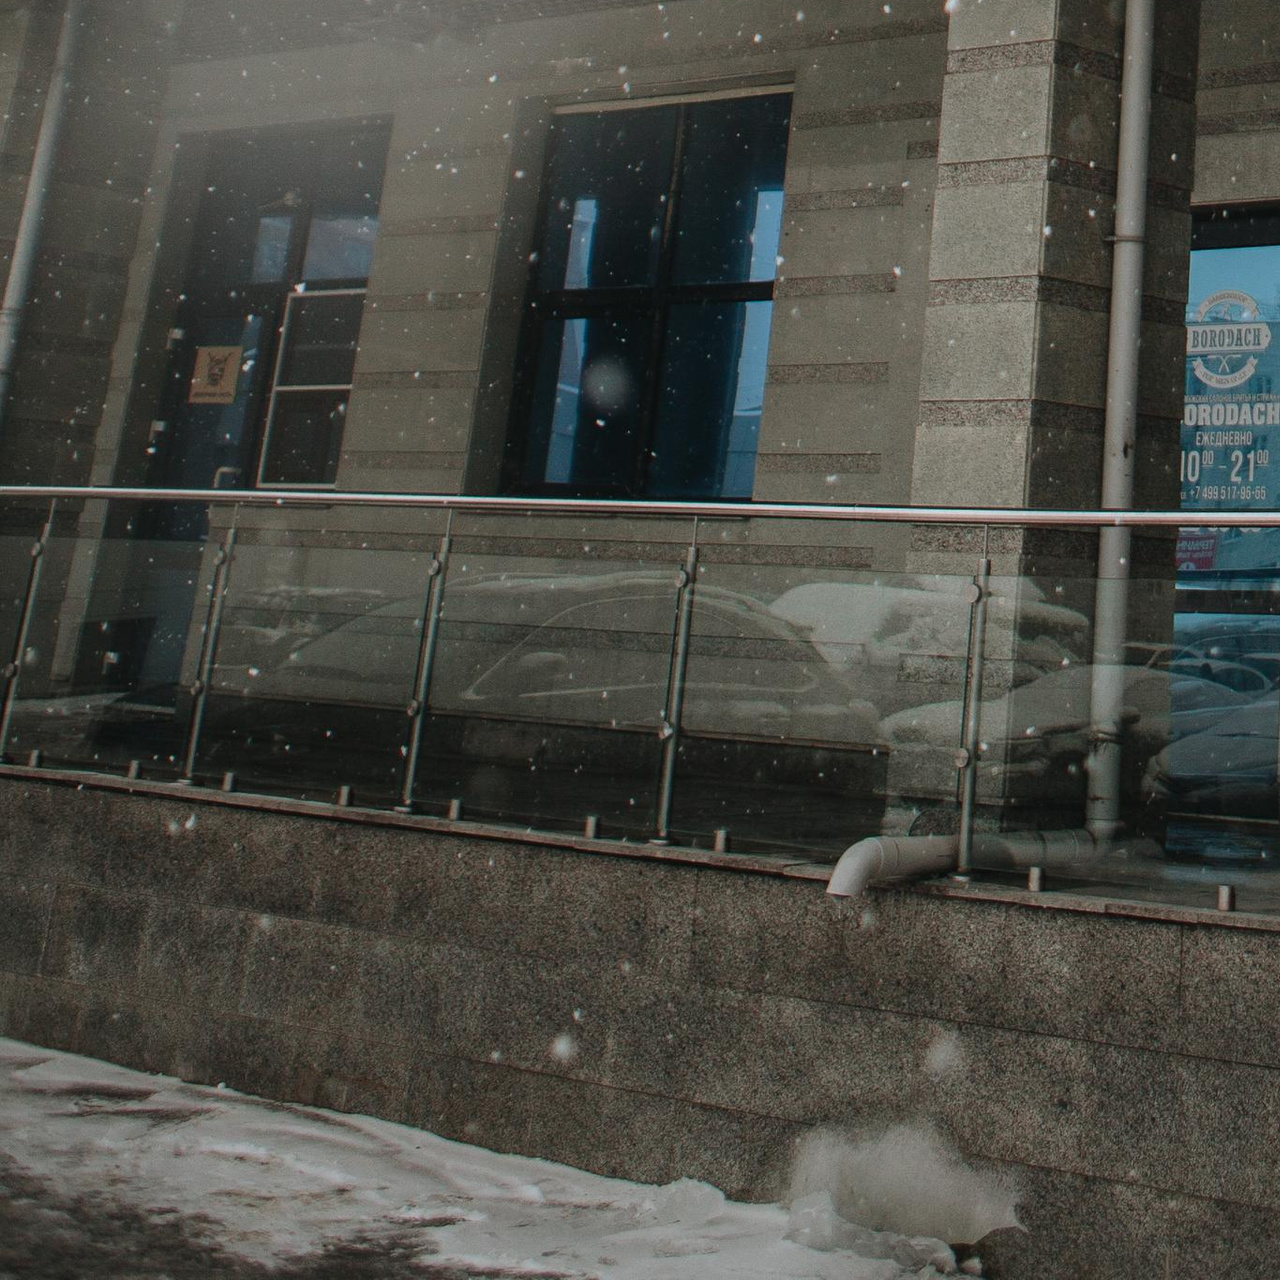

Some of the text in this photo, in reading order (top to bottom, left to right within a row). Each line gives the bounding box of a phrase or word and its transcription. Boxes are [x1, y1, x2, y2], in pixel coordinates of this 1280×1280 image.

[1192, 327, 1262, 348] BORODACH
[1183, 402, 1280, 426] ORODACH
[1195, 430, 1253, 446] ЕЖЕДНЕВНО
